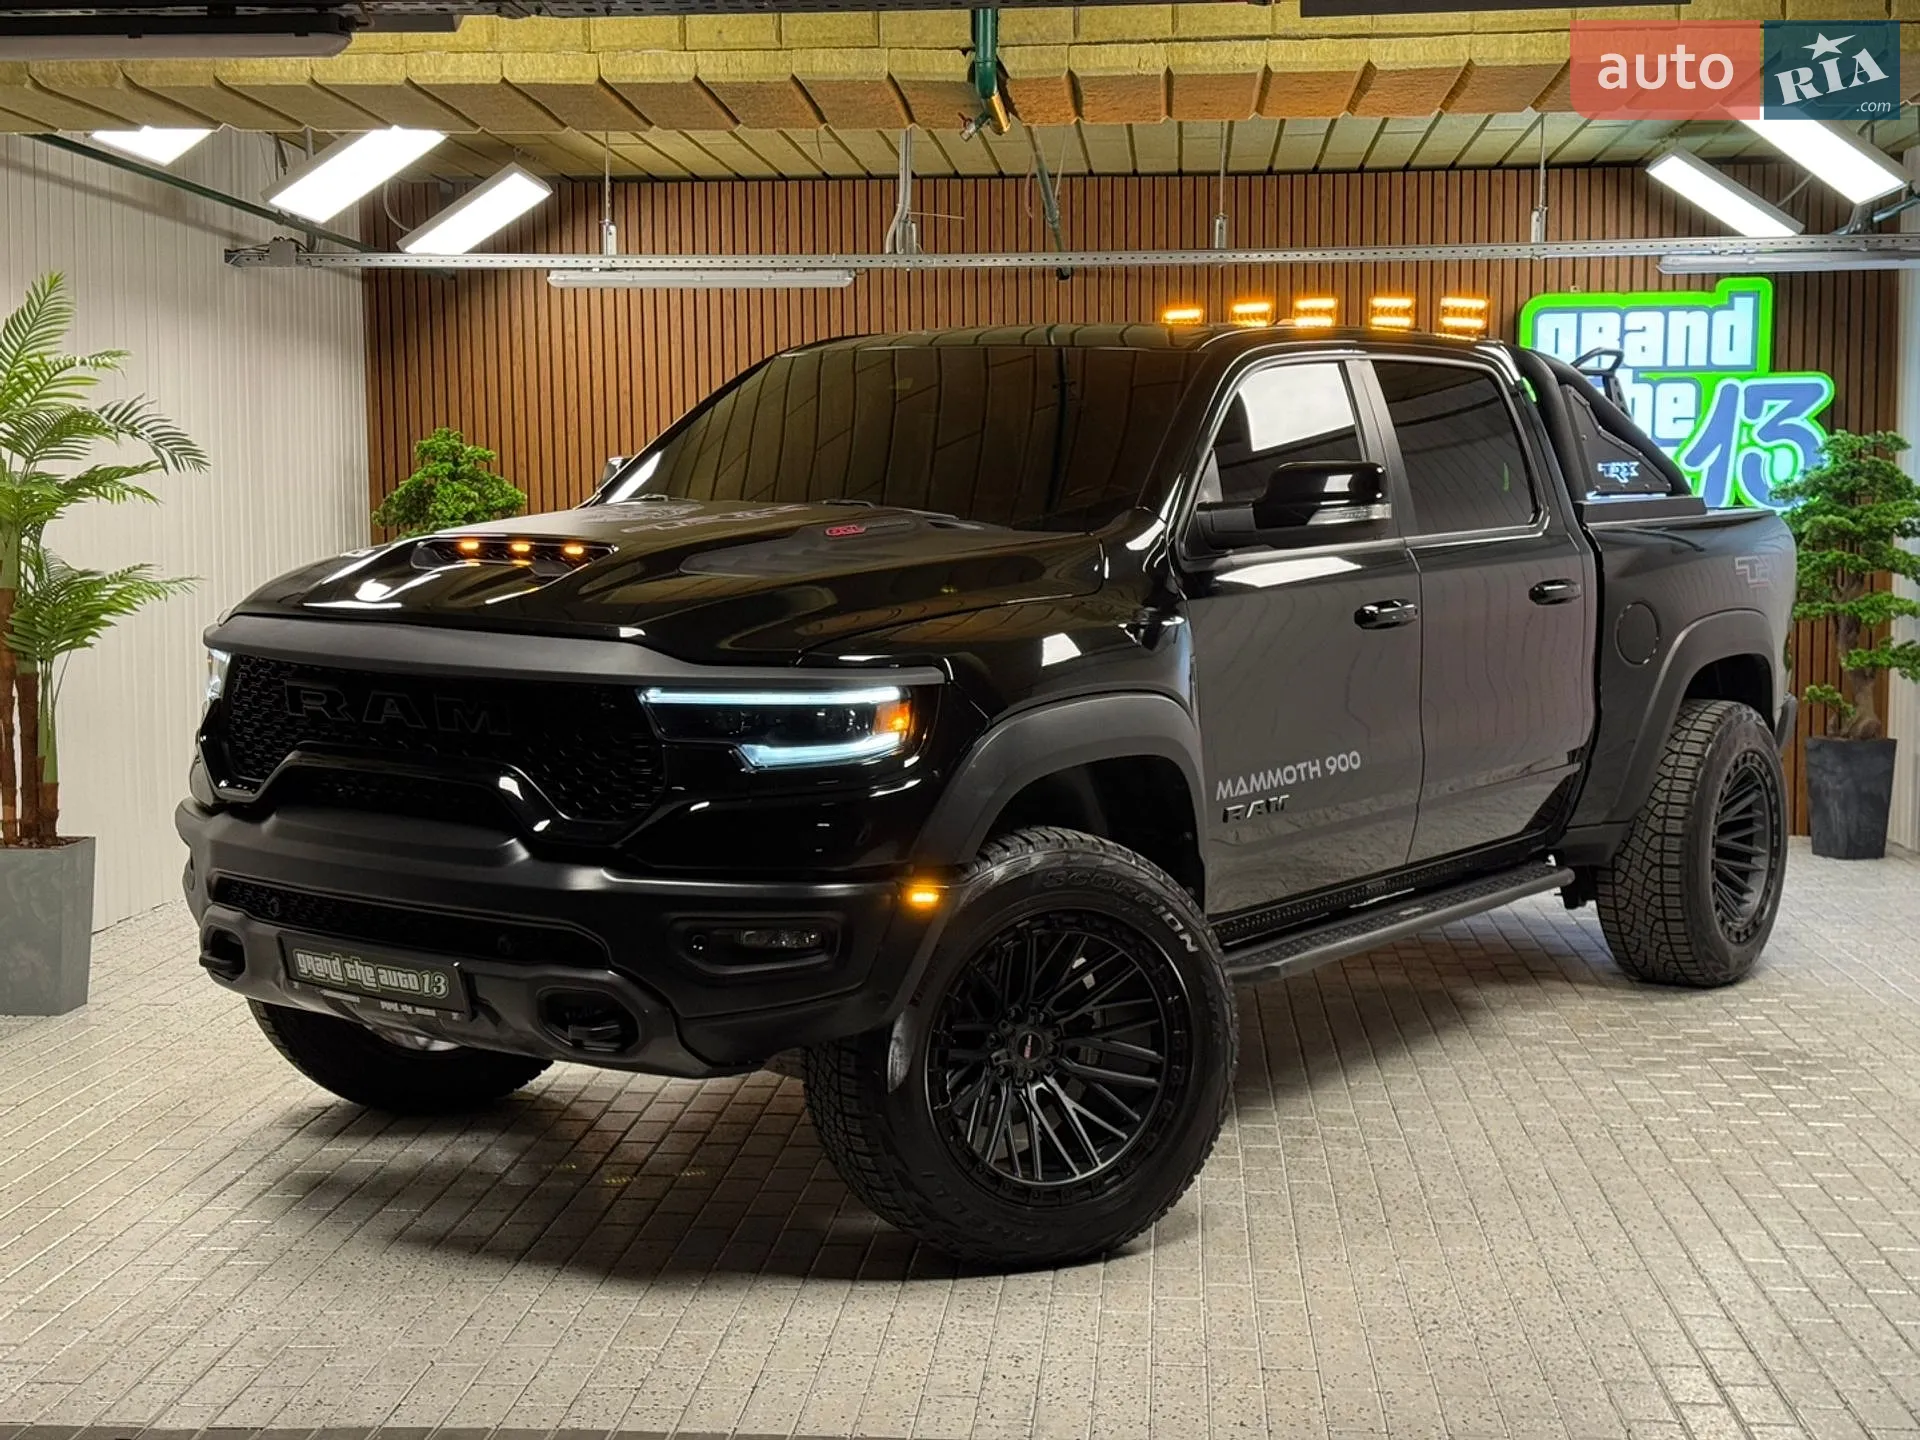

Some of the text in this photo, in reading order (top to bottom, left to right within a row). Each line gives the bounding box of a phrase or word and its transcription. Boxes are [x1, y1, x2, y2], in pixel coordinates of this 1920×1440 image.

[1680, 378, 1827, 512] 13
[283, 678, 513, 736] RAM
[1216, 750, 1361, 801] MAMMOTH 900
[1043, 869, 1200, 952] SCORPION
[378, 967, 421, 991] auto
[421, 972, 449, 997] 13
